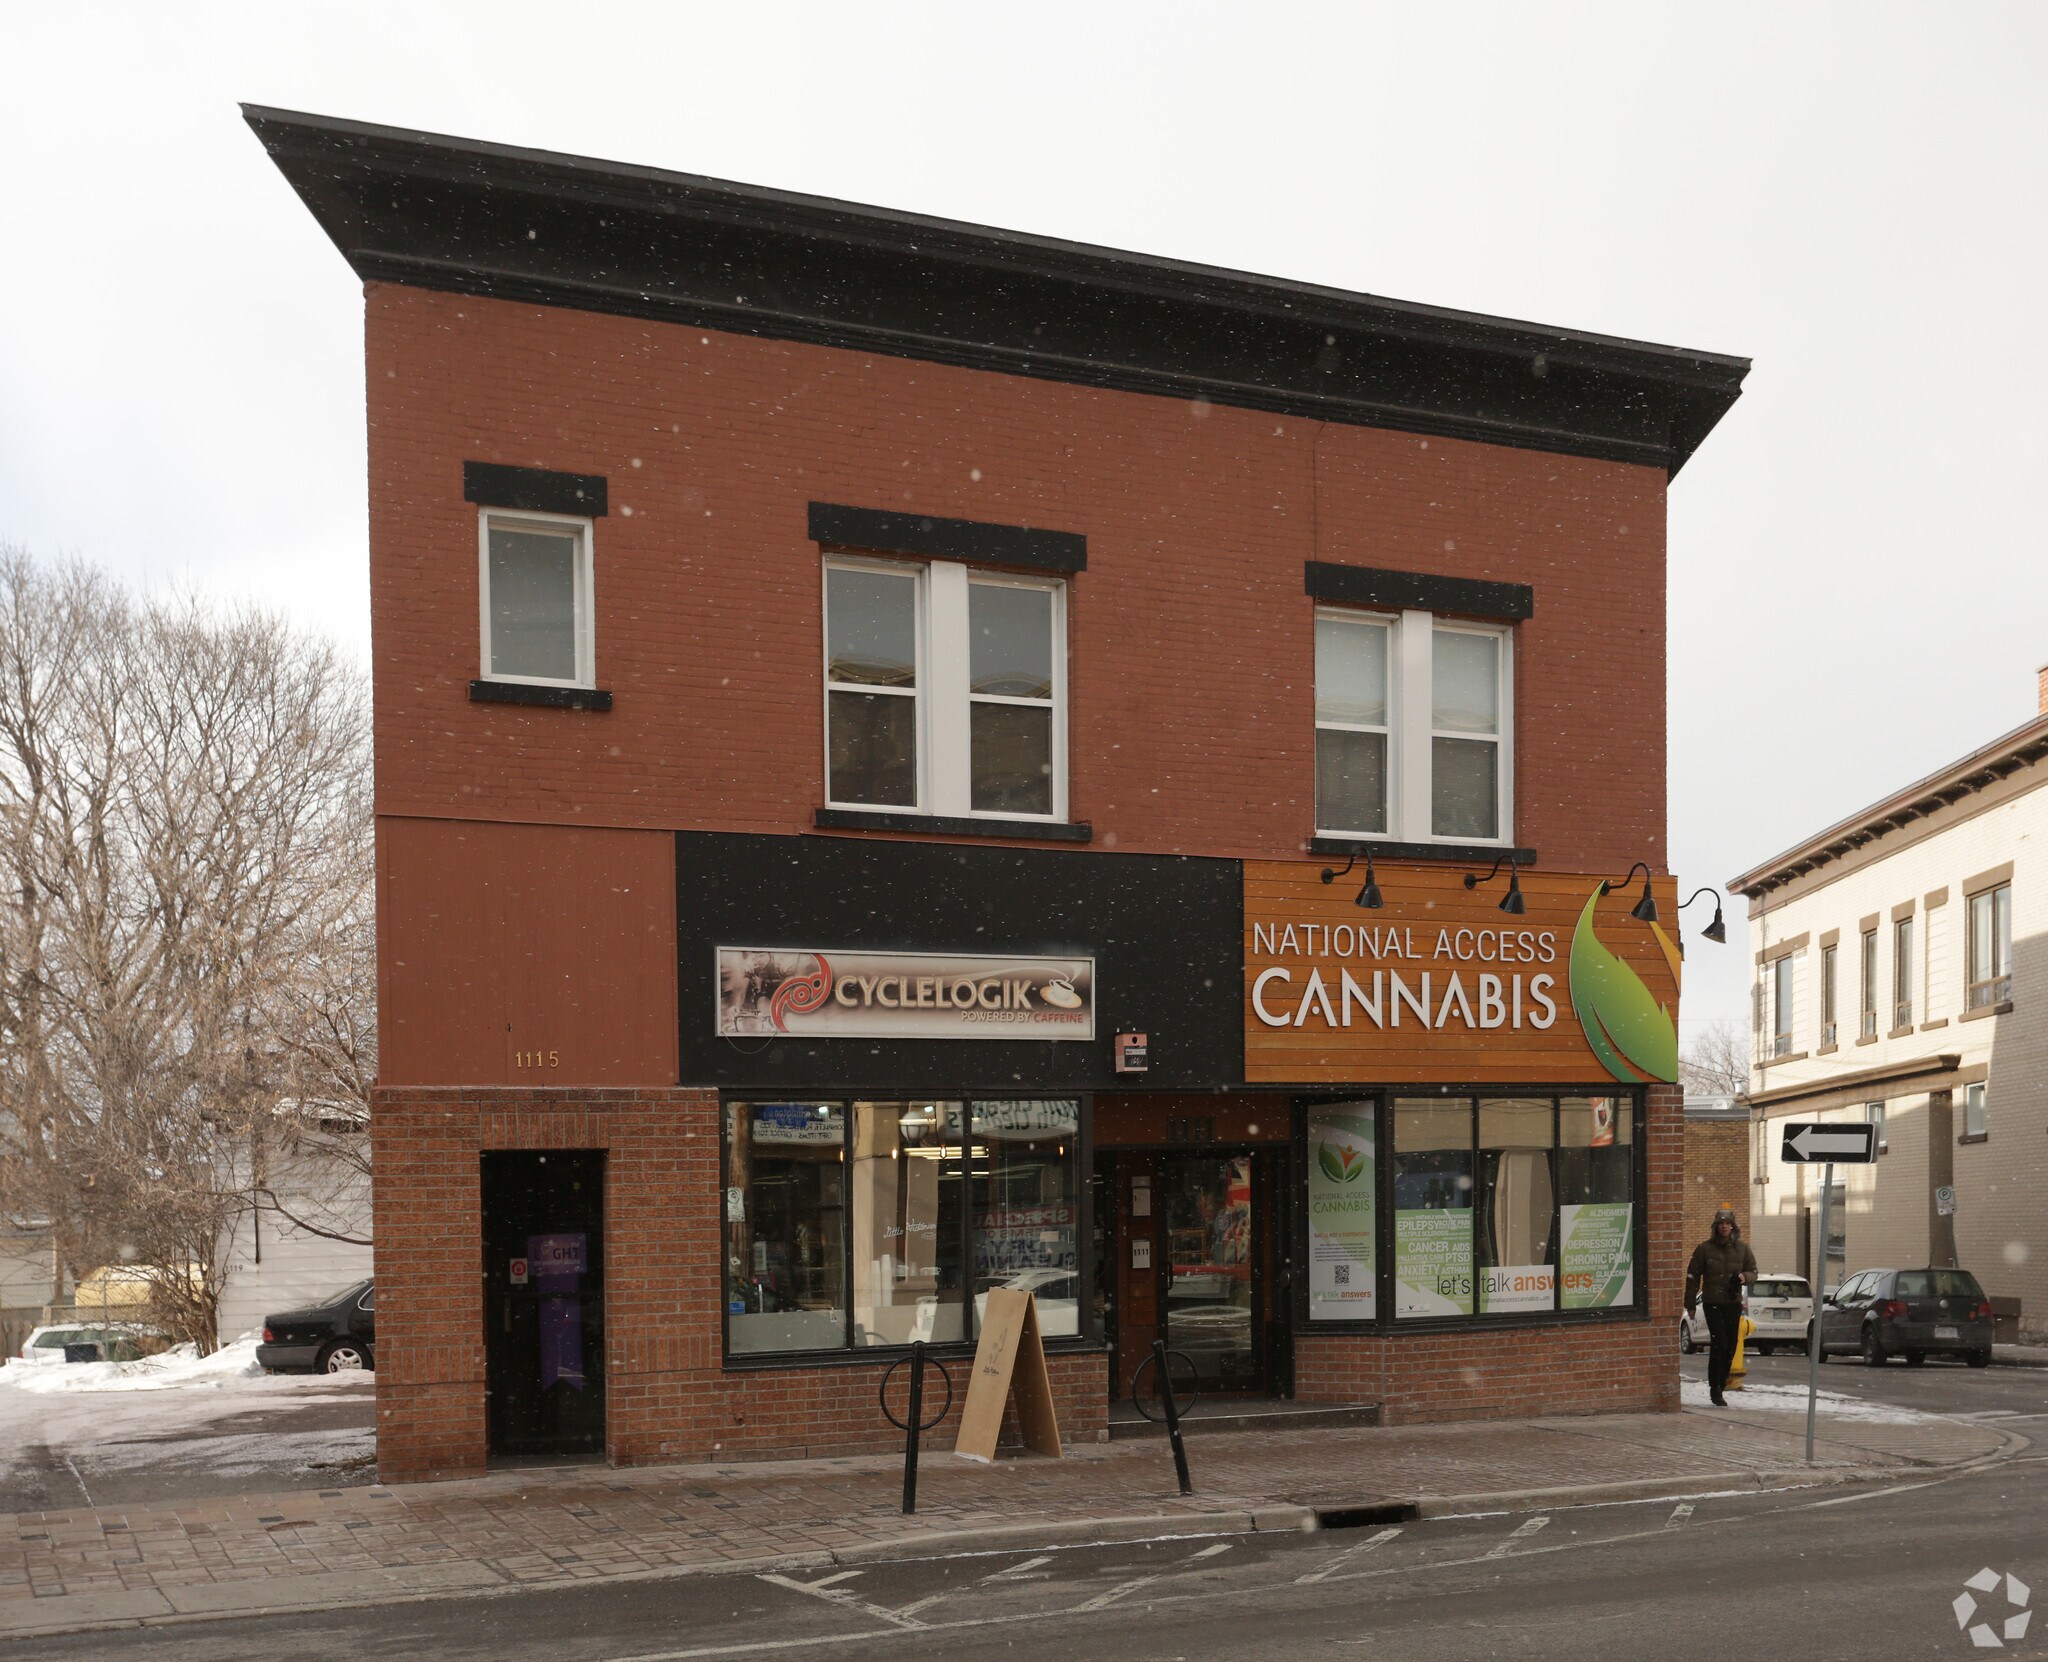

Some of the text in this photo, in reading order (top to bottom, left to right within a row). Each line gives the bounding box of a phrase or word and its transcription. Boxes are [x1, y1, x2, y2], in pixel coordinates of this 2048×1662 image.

[1253, 922, 1556, 963] NATIONAL ACCESS
[834, 975, 1033, 1010] CYCLELOGIK
[1251, 967, 1556, 1030] CANNABIS
[961, 1011, 1083, 1023] POWERED BY CAFFEINE
[515, 1051, 559, 1068] 1115
[1345, 1191, 1370, 1199] ACCESS
[1313, 1200, 1370, 1213] CANNABIS
[1397, 1220, 1440, 1231] EPILEPSY
[1408, 1241, 1470, 1253] CANCER AIDS
[1567, 1238, 1620, 1250] DEPRESSION
[1445, 1252, 1470, 1263] PTSD
[1564, 1252, 1630, 1266] CHRONIC PAIN
[1397, 1264, 1470, 1275] ANXIETY ASTHMA
[1437, 1274, 1471, 1295] let's
[1481, 1273, 1511, 1293] talk
